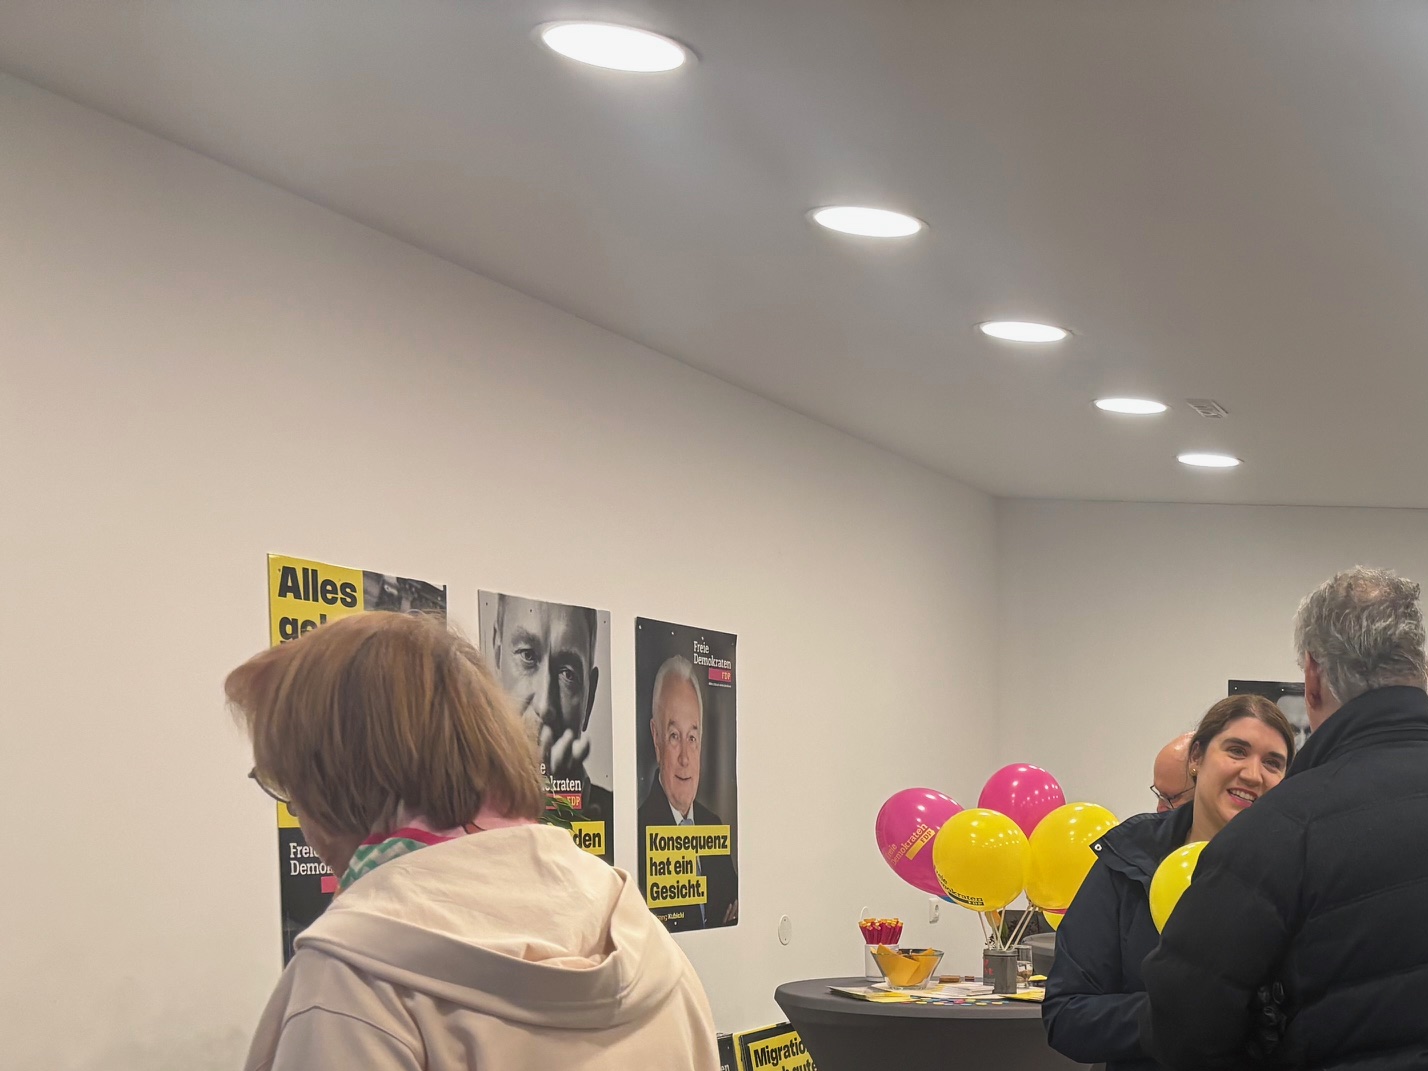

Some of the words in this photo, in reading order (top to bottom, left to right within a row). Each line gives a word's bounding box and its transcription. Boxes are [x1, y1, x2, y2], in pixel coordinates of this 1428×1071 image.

[278, 565, 358, 608] Alles
[693, 640, 710, 653] Freie
[693, 653, 732, 669] Demokraten
[649, 833, 728, 854] Konsequenz
[649, 857, 672, 876] hat
[674, 856, 693, 874] ein
[649, 879, 705, 901] Gesicht.
